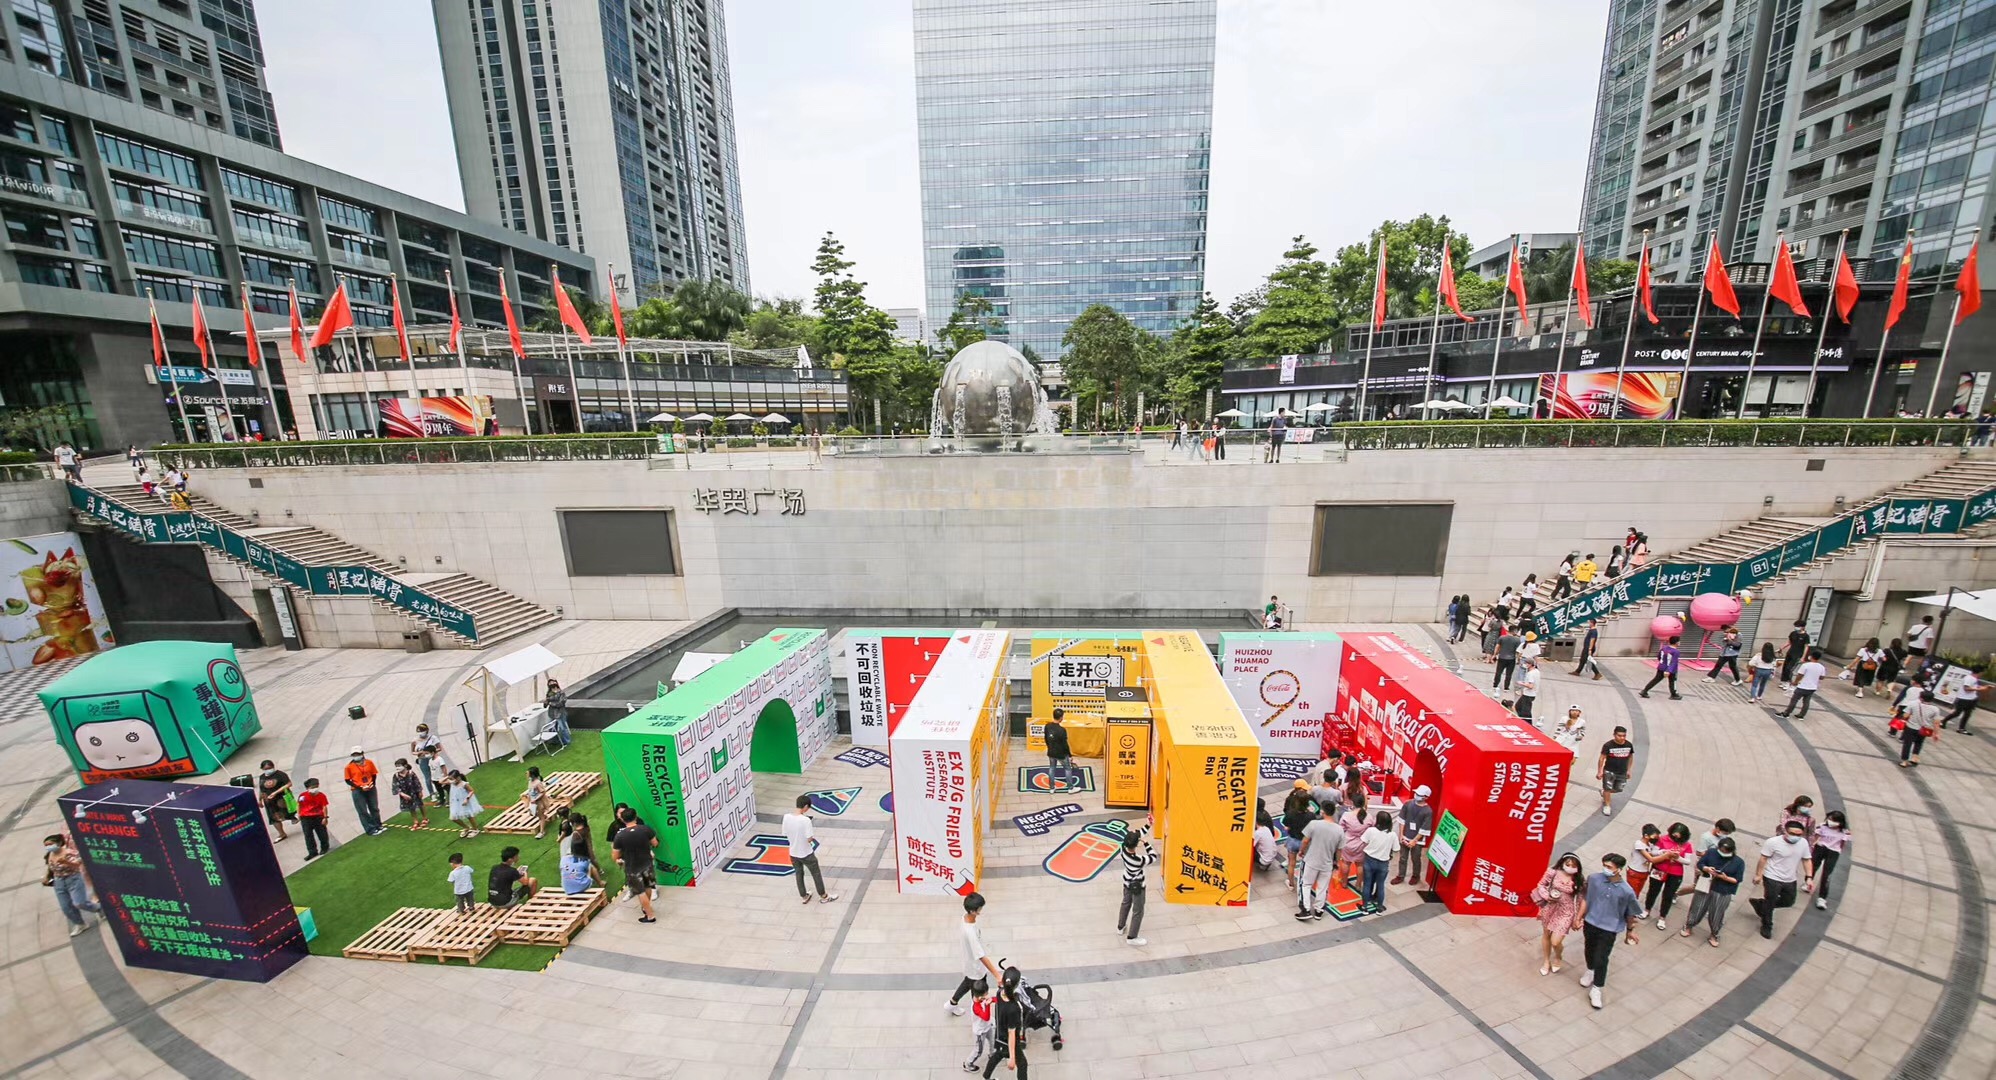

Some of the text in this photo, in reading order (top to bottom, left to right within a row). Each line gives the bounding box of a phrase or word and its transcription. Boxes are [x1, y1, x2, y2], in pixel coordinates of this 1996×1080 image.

[693, 486, 807, 516] 华贸广场
[1753, 561, 1767, 573] B1
[872, 660, 882, 703] RECYCLABLE
[1058, 661, 1093, 678] 走开
[1233, 665, 1259, 673] PLACE
[855, 643, 875, 727] 不可回收垃圾
[192, 682, 233, 753] 事罐重大
[875, 703, 883, 727] WASTE
[1298, 701, 1310, 710] th
[1269, 730, 1322, 738] BIRTHDAY
[641, 743, 662, 807] LABORATORY
[922, 750, 935, 800] INSTITUTE
[935, 751, 948, 802] RESEARCH
[1204, 756, 1216, 775] BIN
[1216, 756, 1229, 801] RECYCLE
[1260, 763, 1304, 772] WASTE
[1509, 762, 1522, 783] GAS
[653, 744, 679, 828] RECYCLING
[1230, 757, 1249, 832] NEGATIVE
[1487, 762, 1506, 803] STATION
[1508, 763, 1541, 820] WASTE
[945, 751, 965, 859] EX B/G FRIEND
[1017, 805, 1079, 825] NEGATIVE
[1525, 763, 1561, 843] WIRHOUT
[77, 821, 140, 838] OF CHANGE
[1022, 816, 1060, 830] RECYCLE
[1026, 827, 1045, 835] BIN
[908, 851, 955, 883] 研究所
[1181, 844, 1226, 873] 负能量
[1475, 857, 1506, 873] 天下
[1180, 860, 1229, 892] 回收站
[121, 893, 182, 913] 循环实验室
[1471, 877, 1520, 905] 能量池
[130, 909, 190, 928] 前任研究所
[140, 924, 213, 945] 负能量回收站
[148, 939, 233, 961] 天下无废能量池
